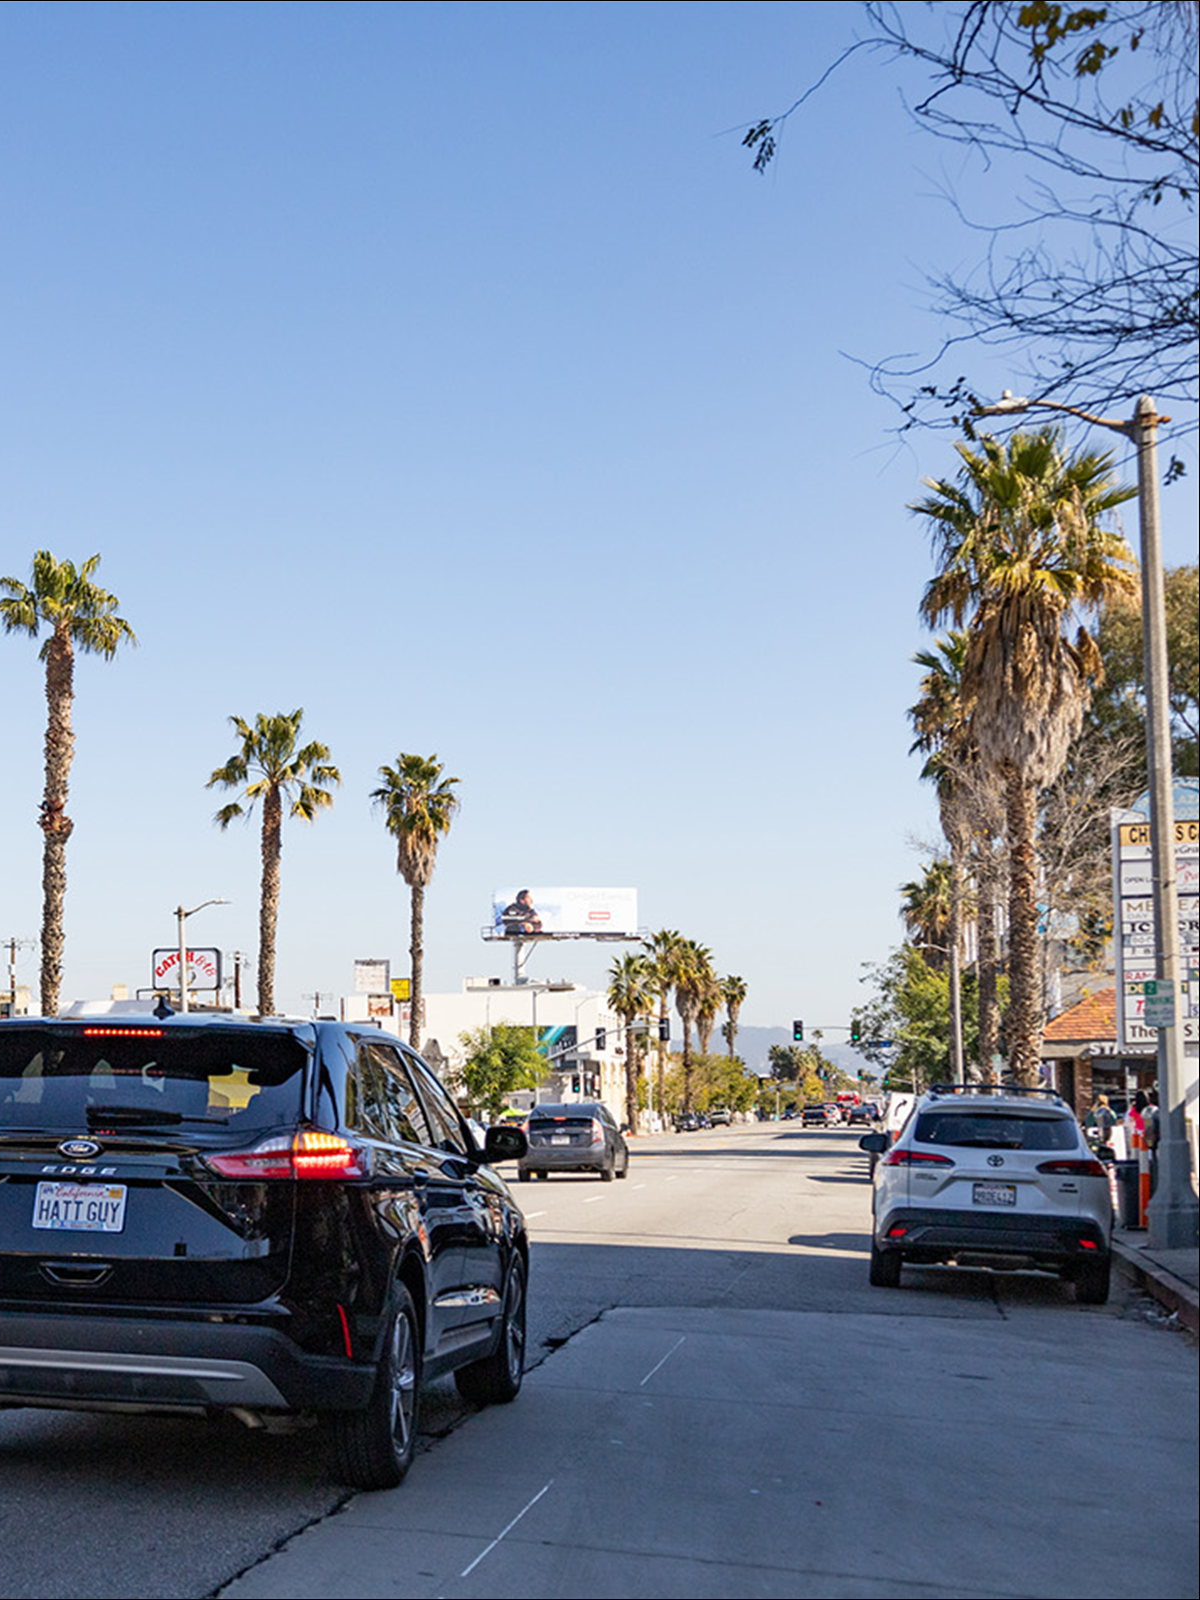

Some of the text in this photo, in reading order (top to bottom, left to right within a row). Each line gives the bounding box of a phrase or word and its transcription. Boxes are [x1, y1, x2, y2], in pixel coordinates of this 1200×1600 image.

[195, 955, 217, 977] 818
[1130, 1025, 1158, 1038] The
[42, 1165, 117, 1175] EDGE
[39, 1200, 121, 1223] HATT GUY
